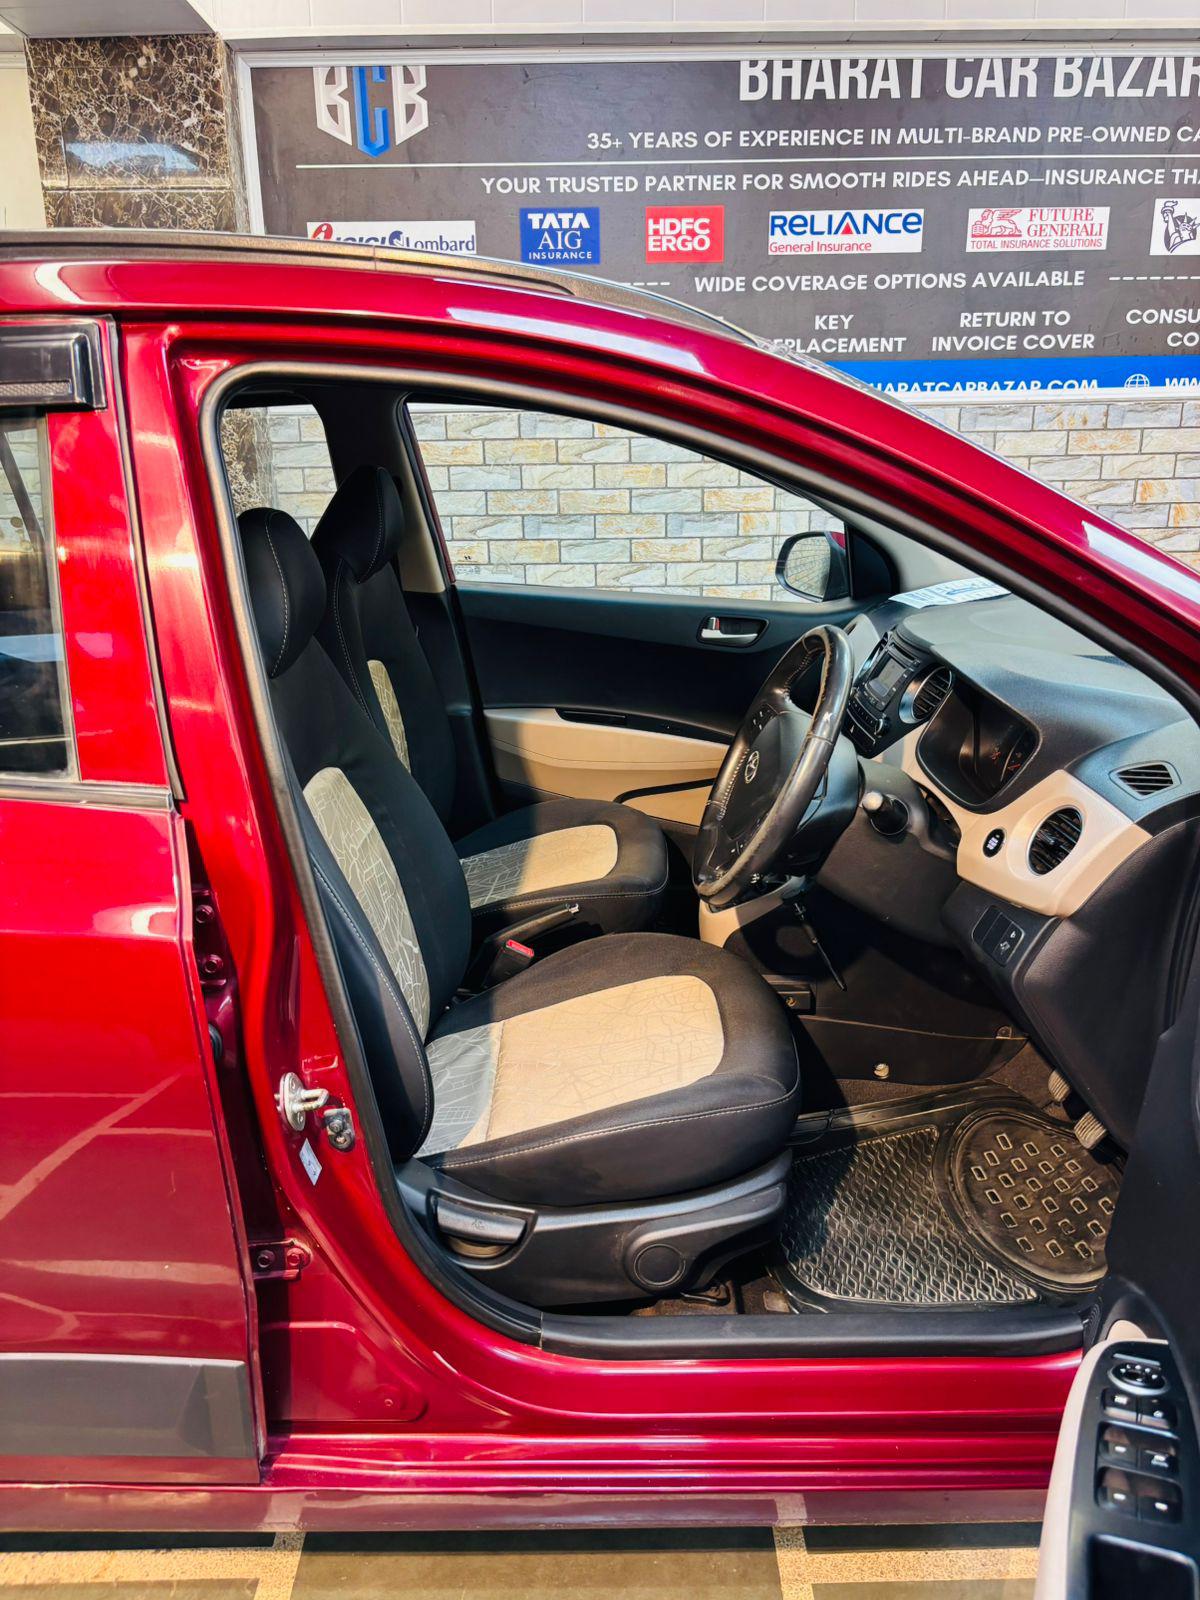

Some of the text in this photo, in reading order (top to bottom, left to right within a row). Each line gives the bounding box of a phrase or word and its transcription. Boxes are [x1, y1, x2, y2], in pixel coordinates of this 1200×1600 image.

[740, 59, 924, 101] BHARAT
[945, 58, 1038, 98] CAR
[313, 65, 429, 158] BCB
[587, 132, 622, 149] 35+
[628, 131, 698, 149] YEARS
[704, 130, 733, 147] OF
[739, 128, 864, 147] EXPERIENCE
[870, 128, 892, 145] IN
[896, 126, 1042, 145] MULTI-BRAND
[1047, 126, 1171, 143] PRE-OWNED
[481, 177, 541, 194] YOUR
[546, 175, 639, 193] TRUSTED
[645, 173, 736, 192] PARTNER
[742, 173, 784, 191] FOR
[789, 171, 886, 190] SMOOTH
[892, 170, 951, 188] RIDES
[1171, 168, 1200, 185] TH
[527, 212, 590, 229] TATA
[1029, 208, 1094, 222] FUTURE
[648, 218, 711, 235] HDFC
[1027, 222, 1103, 238] GENERALI
[538, 231, 582, 250] AIG
[648, 234, 711, 251] ERGO
[769, 241, 872, 253] General Insurance
[971, 238, 1103, 249] TOTAL INSURANCE SOLUTIONS
[528, 251, 592, 260] INSURANCE
[694, 270, 1085, 292] WIDE COVERAGE OPTIONS AVAILABLE
[814, 314, 854, 330] KEY
[960, 310, 1071, 328] RETURN TO
[932, 333, 1095, 352] INVOICE COVER
